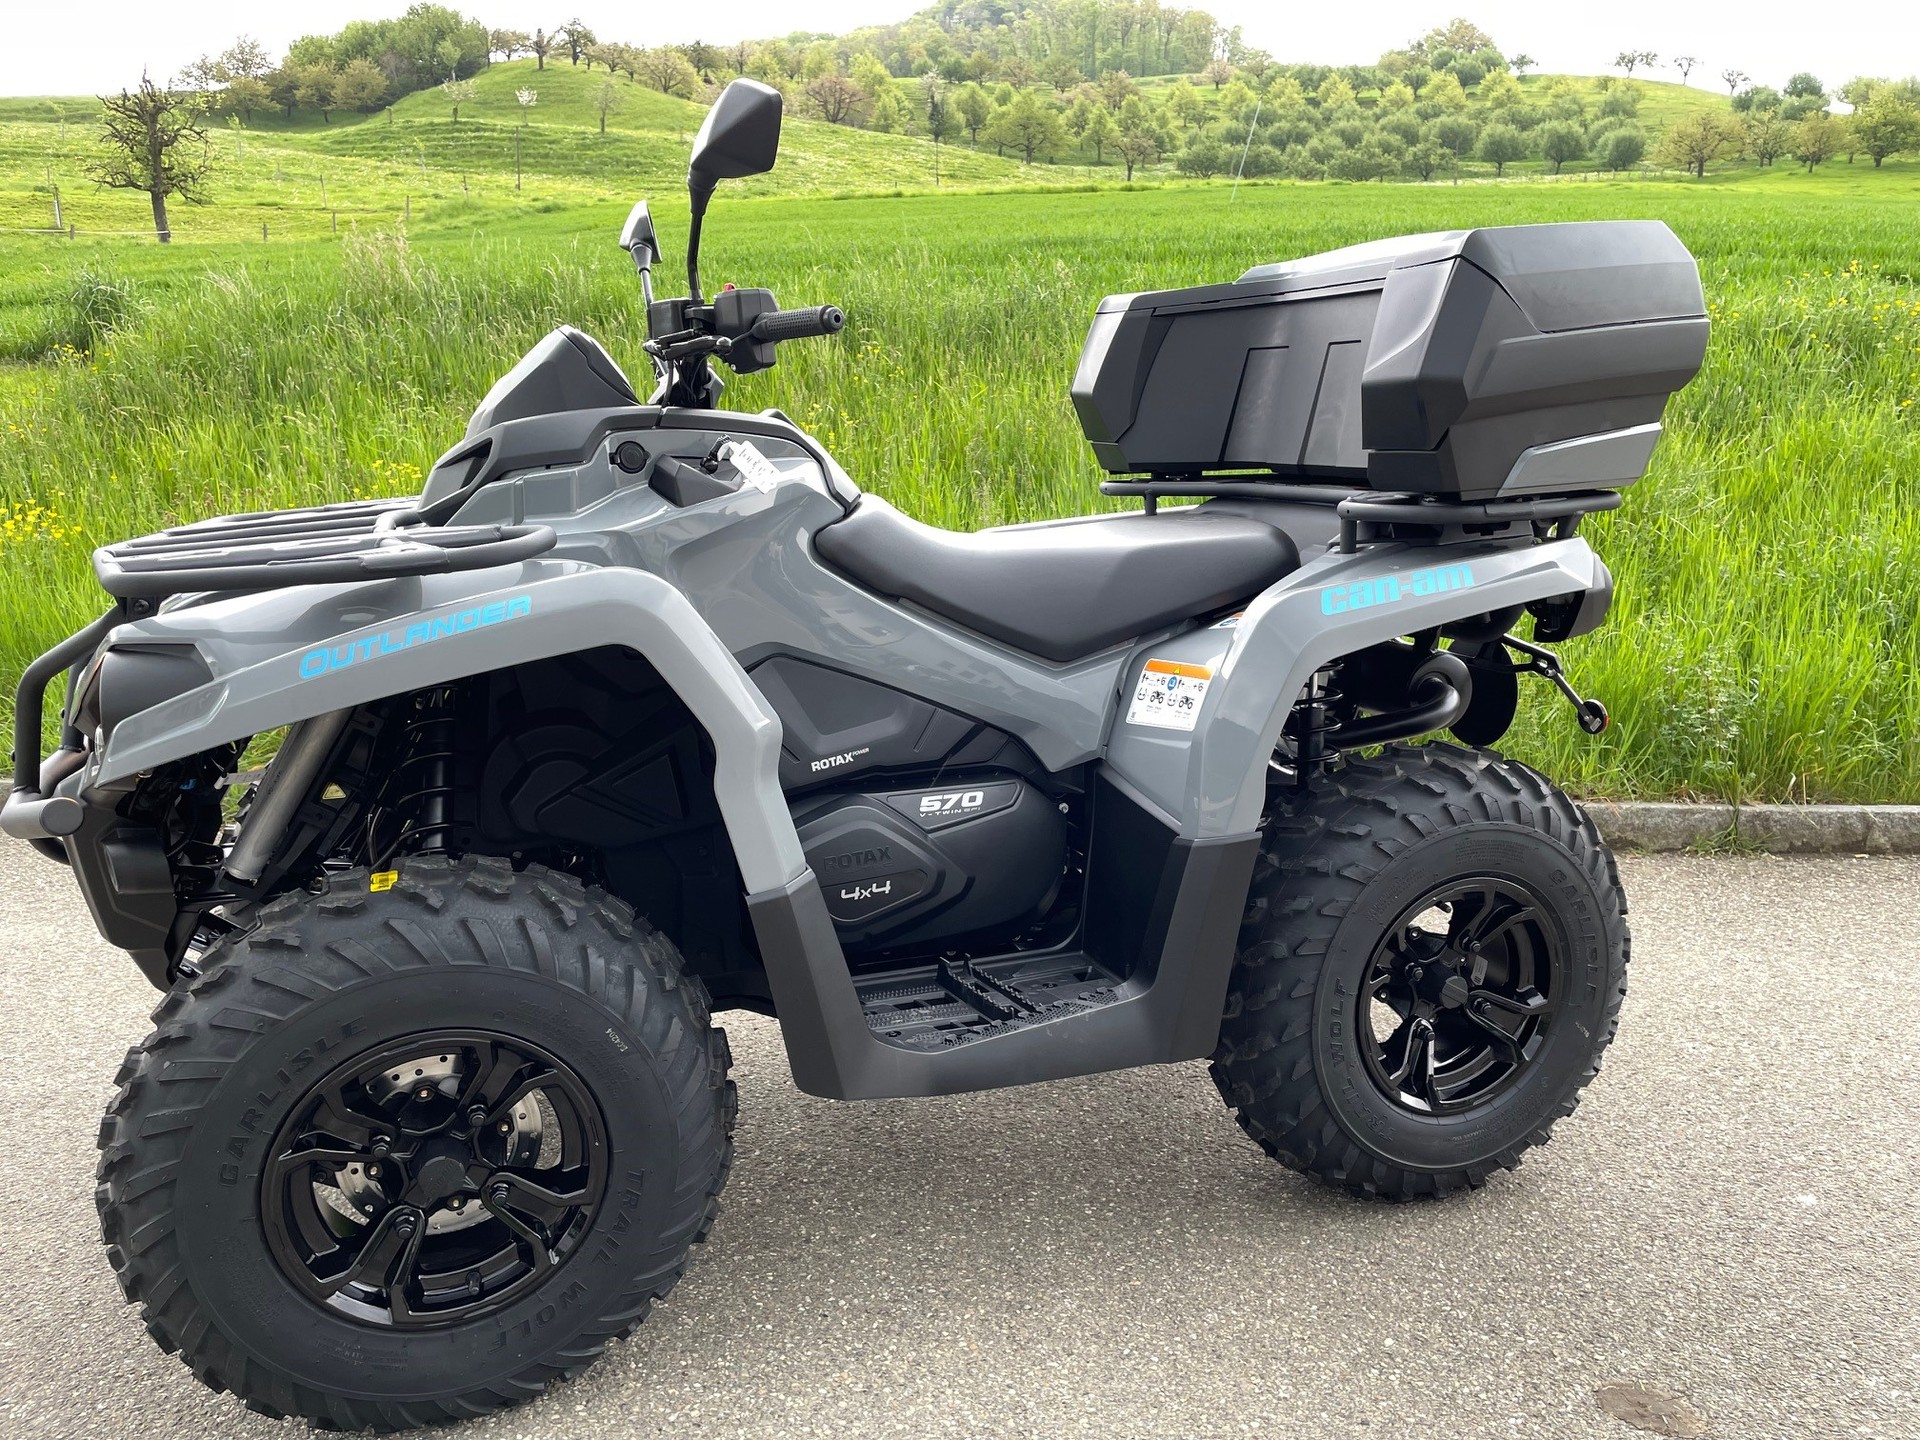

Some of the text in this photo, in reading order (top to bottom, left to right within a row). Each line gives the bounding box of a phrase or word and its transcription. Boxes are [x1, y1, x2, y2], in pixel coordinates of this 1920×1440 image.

[1320, 563, 1475, 616] can-am
[299, 595, 532, 679] OUTLANDER
[811, 747, 870, 772] ROTAX POWER
[920, 791, 984, 812] 570
[824, 845, 892, 872] ROTAX
[840, 880, 891, 901] 4x4
[1550, 868, 1599, 1001] CARLISLE
[1329, 977, 1347, 1068] WOLF
[219, 1016, 368, 1188] CARLISLE
[590, 1167, 646, 1265] TRAIL
[488, 1279, 589, 1353] WOLF
